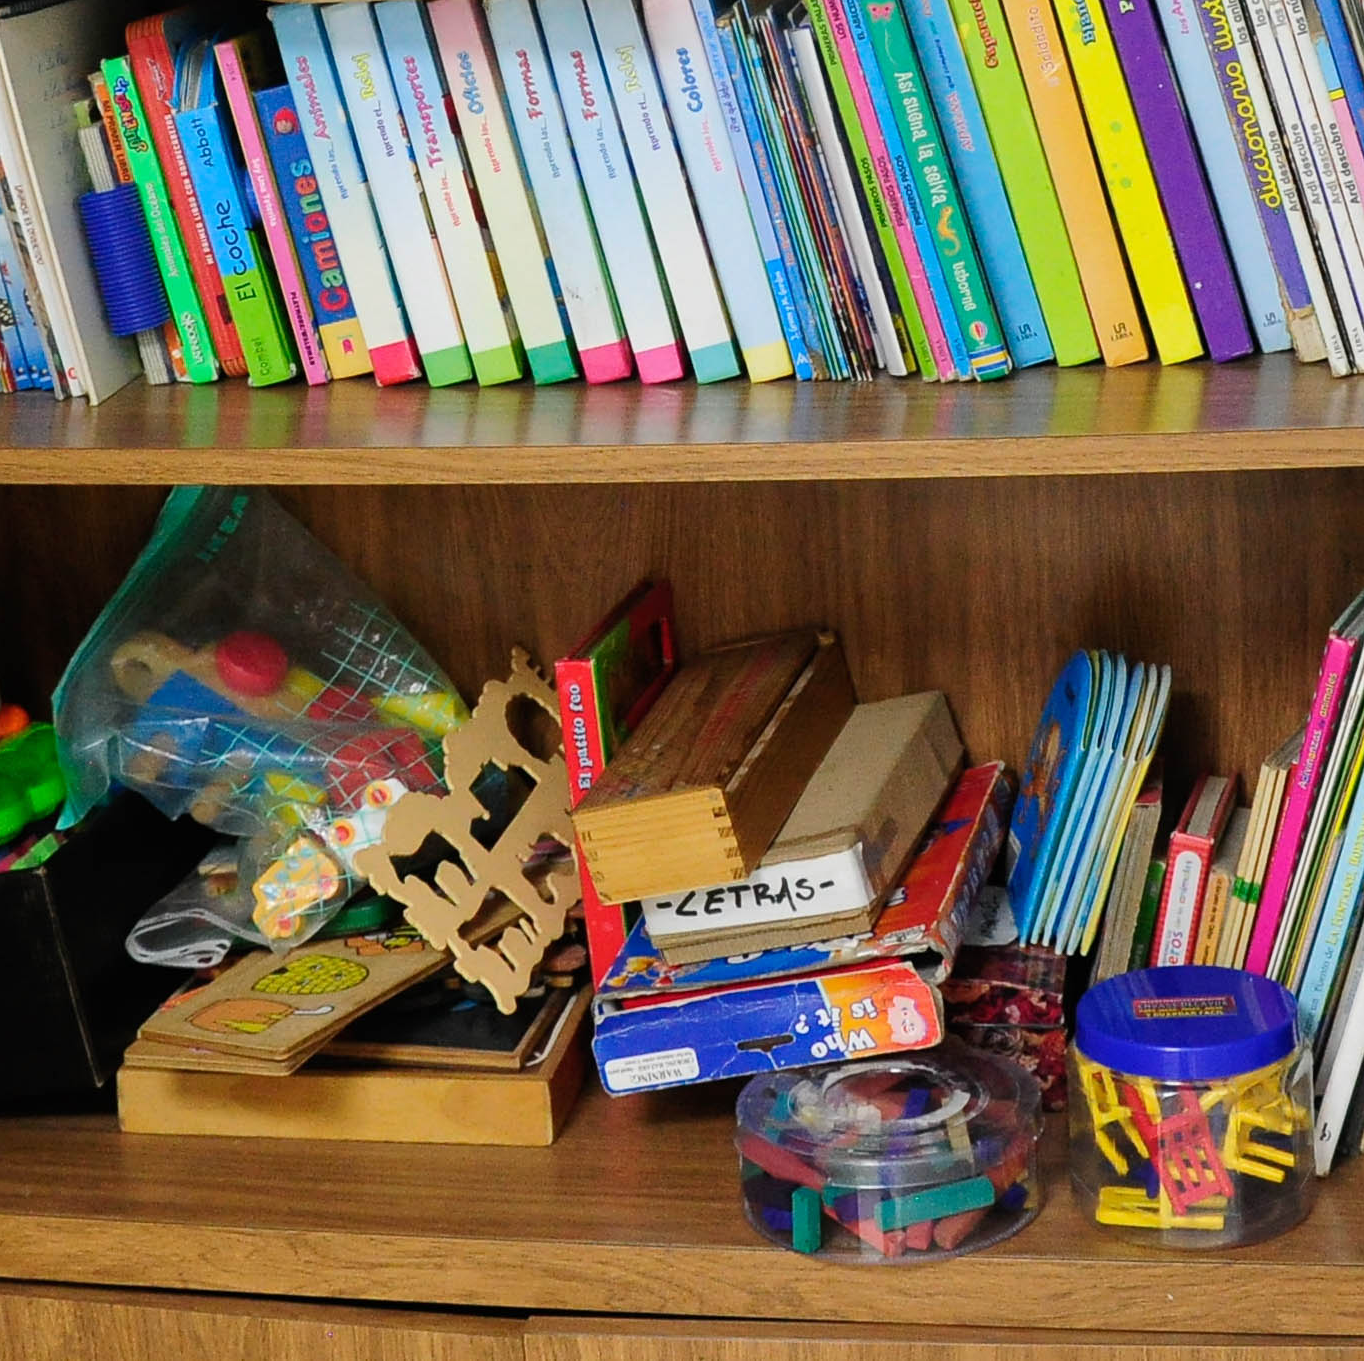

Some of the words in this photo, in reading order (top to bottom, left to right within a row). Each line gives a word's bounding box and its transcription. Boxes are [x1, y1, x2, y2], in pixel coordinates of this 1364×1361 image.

[817, 21, 839, 66] PRIMERAS
[834, 21, 847, 40] LOS
[1026, 5, 1055, 72] Soldadito
[349, 52, 380, 100] Reloj
[450, 50, 487, 116] Oficios
[511, 48, 544, 120] Formas
[564, 49, 600, 121] Formas
[614, 43, 645, 92] Reloj
[670, 46, 706, 114] Colores
[893, 69, 917, 95] Así
[288, 54, 334, 142] Animales
[397, 52, 448, 168] Transportes
[899, 94, 929, 142] suena
[189, 116, 216, 168] Abbott
[374, 118, 395, 157] Aprendo
[640, 111, 660, 151] Aprendo
[914, 141, 938, 163] la
[1220, 59, 1282, 211] diccionario
[1287, 122, 1314, 181] descubre
[1326, 121, 1353, 179] descubre
[859, 156, 875, 184] PASOS
[876, 155, 892, 183] PASOS
[893, 153, 909, 181] PASOS
[1266, 128, 1293, 188] descubre
[868, 185, 890, 228] PRIMEROS
[885, 183, 906, 227] PRIMEROS
[903, 182, 923, 226] PRIMEROS
[920, 161, 952, 207] selva
[157, 234, 181, 278] Animales
[213, 198, 248, 277] coche
[282, 157, 351, 314] Camiones
[233, 281, 256, 301] El
[564, 682, 583, 712] feo
[569, 716, 593, 768] patito
[1295, 727, 1324, 791] Adivinanzas
[1316, 670, 1339, 718] animales
[576, 772, 593, 790] El
[851, 997, 878, 1020] is
[811, 1028, 877, 1058] Who
